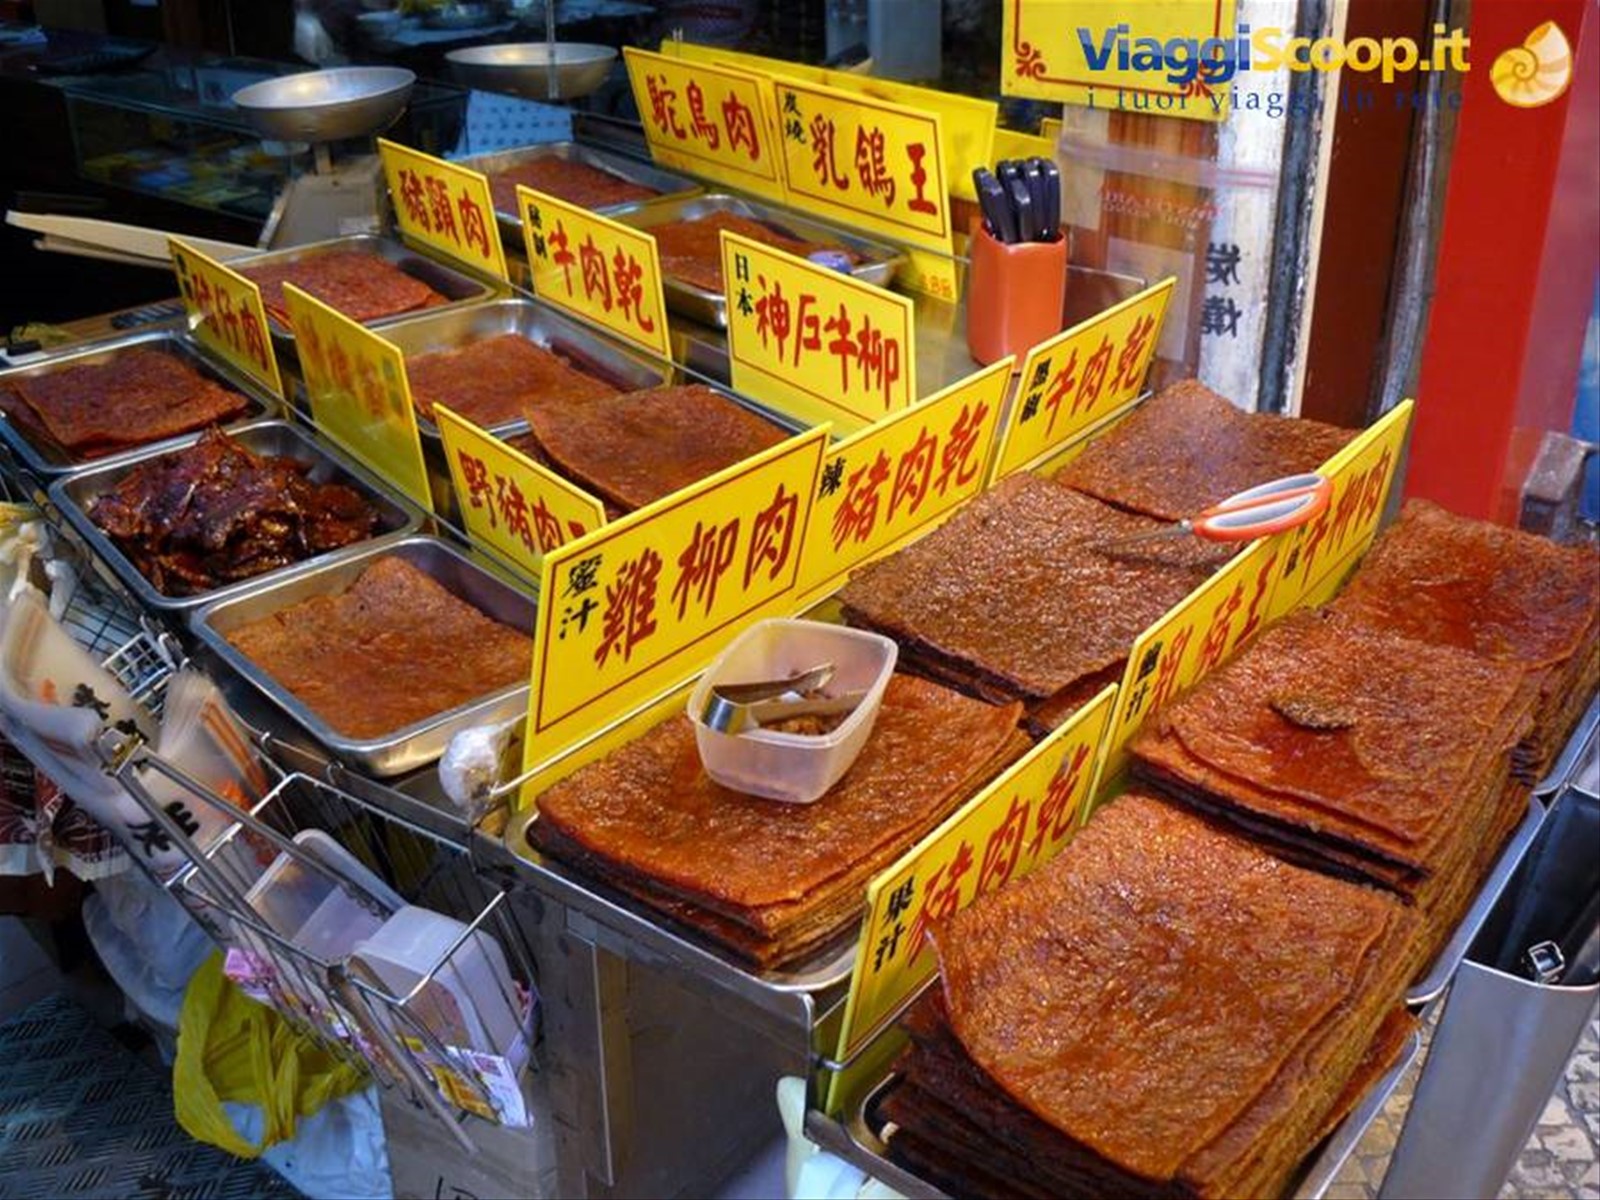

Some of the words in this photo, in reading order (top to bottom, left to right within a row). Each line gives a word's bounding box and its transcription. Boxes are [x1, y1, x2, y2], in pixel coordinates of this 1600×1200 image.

[809, 113, 938, 216] 乳鴿王
[548, 218, 655, 333] 牛肉乾
[735, 253, 753, 316] 日本
[1044, 314, 1155, 440] 牛肉乾
[457, 448, 588, 556] 野豬肉
[832, 400, 988, 553] 豬肉乾
[594, 483, 799, 670] 雞柳肉
[905, 742, 1091, 968] 豬肉乾
[873, 876, 915, 974] 果汁
